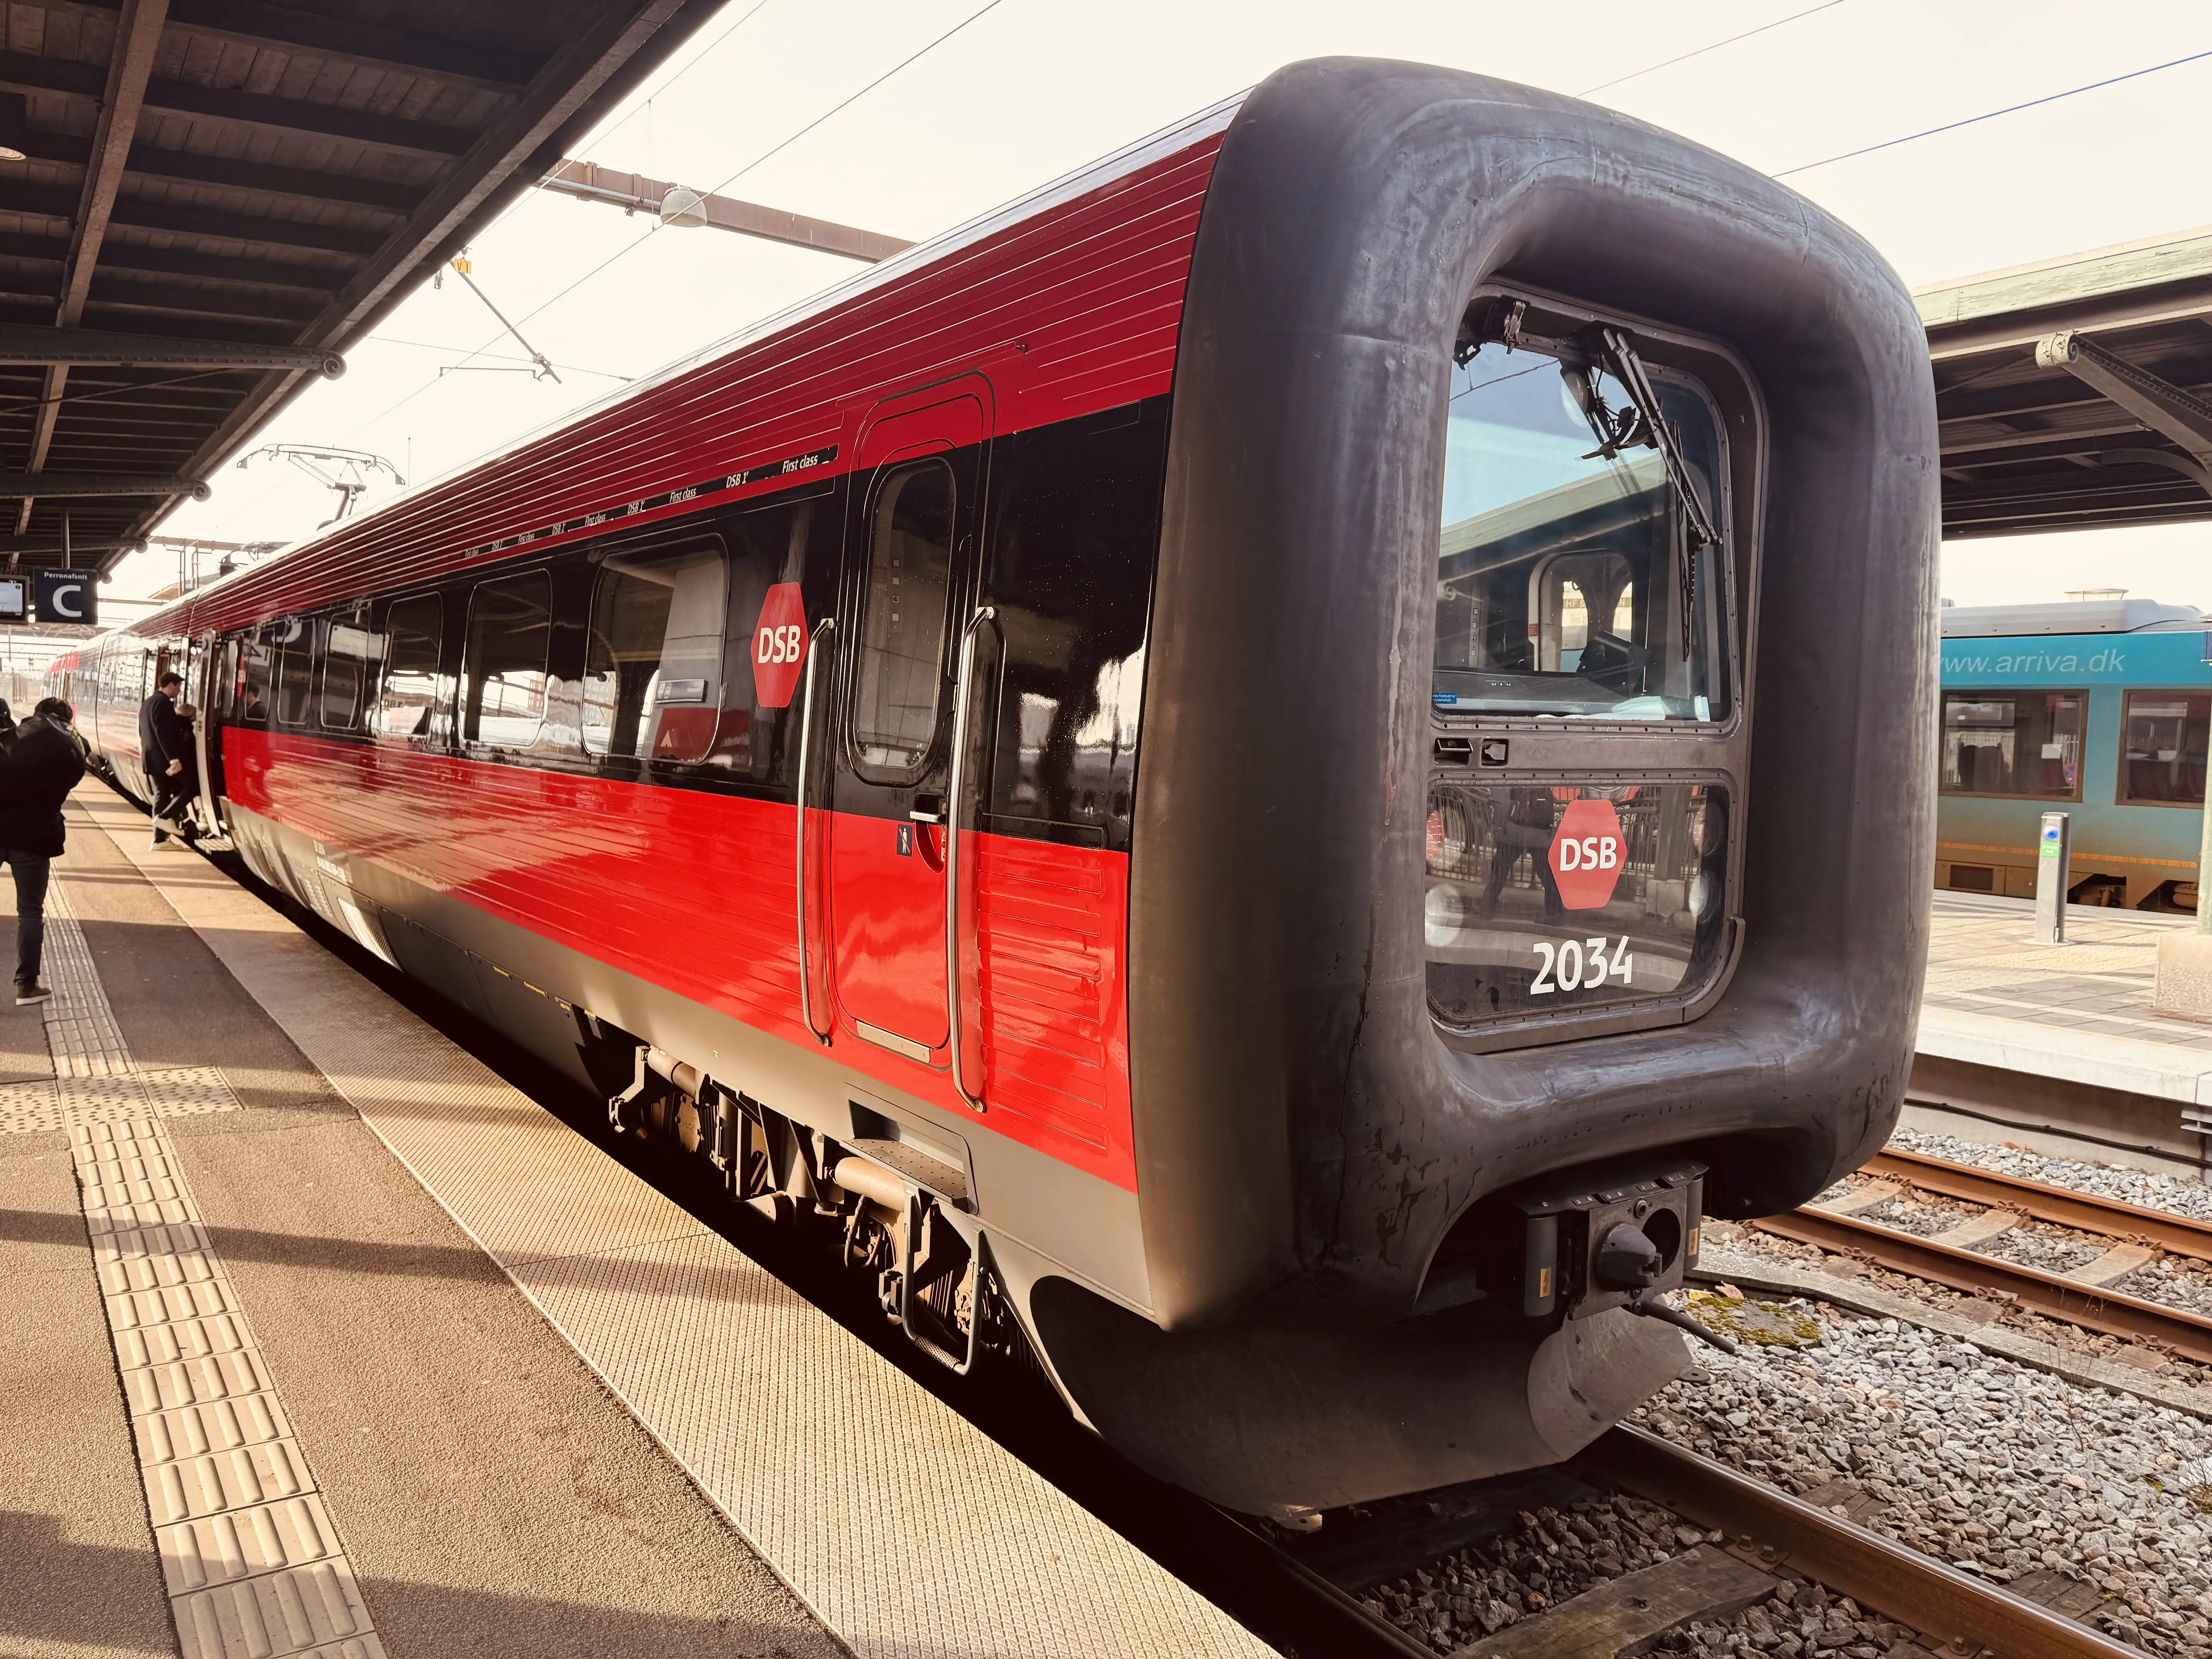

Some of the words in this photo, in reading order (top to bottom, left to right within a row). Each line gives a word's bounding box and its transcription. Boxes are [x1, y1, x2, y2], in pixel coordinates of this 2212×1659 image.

[518, 535, 526, 543] First
[526, 532, 534, 542] class
[552, 524, 561, 534] DSB
[585, 517, 594, 526] First
[595, 512, 606, 524] class
[628, 502, 639, 514] DSB
[670, 492, 682, 503] First
[682, 488, 696, 500] class
[726, 474, 741, 488] DSB
[782, 459, 798, 474] First
[800, 455, 818, 469] class
[44, 571, 88, 580] Perronafsnit
[53, 584, 82, 617] C
[758, 625, 801, 663] DSB
[1940, 649, 2126, 672] ww.arriva.dk
[1559, 836, 1617, 871] DSB
[1530, 935, 1632, 995] 2034
